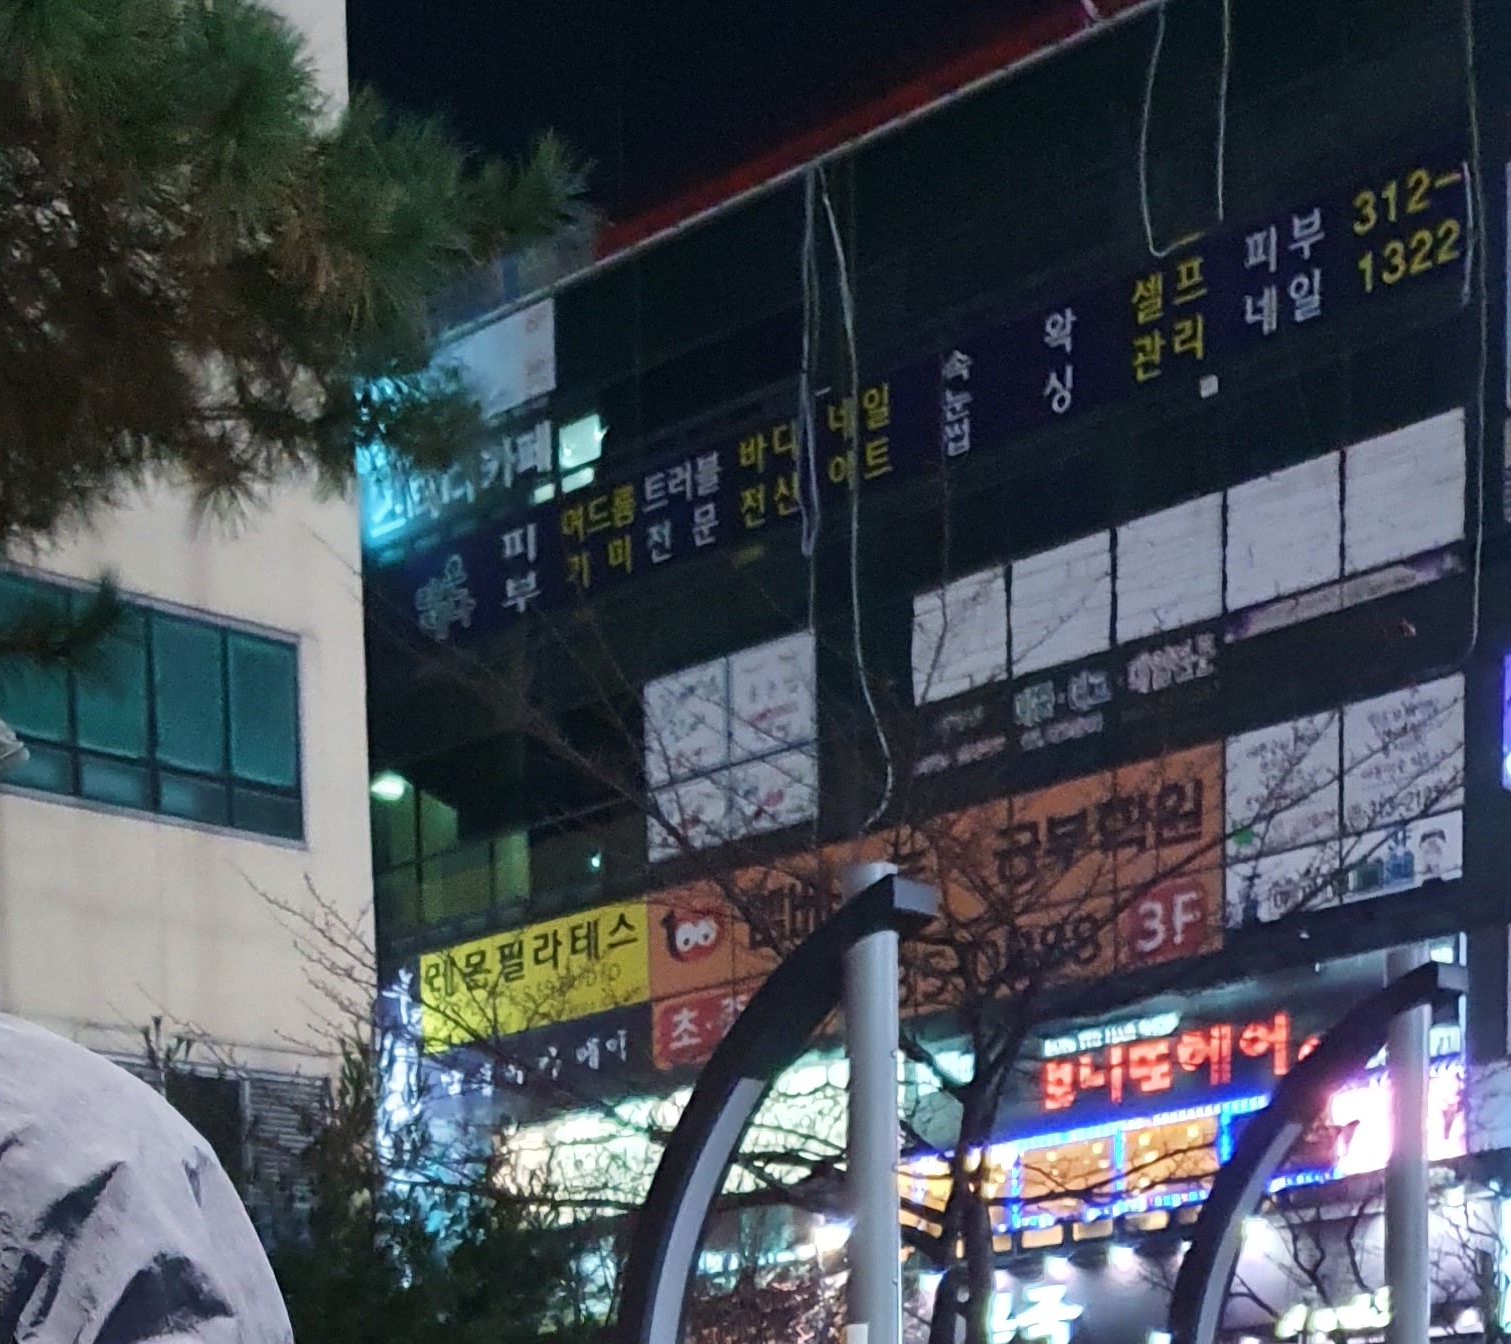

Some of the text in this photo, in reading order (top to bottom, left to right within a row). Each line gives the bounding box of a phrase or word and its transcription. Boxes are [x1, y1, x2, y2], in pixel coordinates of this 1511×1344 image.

[1352, 169, 1462, 236] 312-
[1132, 207, 1325, 325] 셀프 피부
[1357, 219, 1461, 294] 1322
[1043, 307, 1077, 414] 왁싱
[1132, 268, 1321, 382] 관리 네일
[643, 452, 722, 513] 트러블
[739, 421, 800, 473] 바디
[501, 523, 543, 613] 피부
[648, 502, 719, 564] 전문
[424, 913, 638, 997] 레몬필라테스
[1137, 892, 1201, 952] 3F
